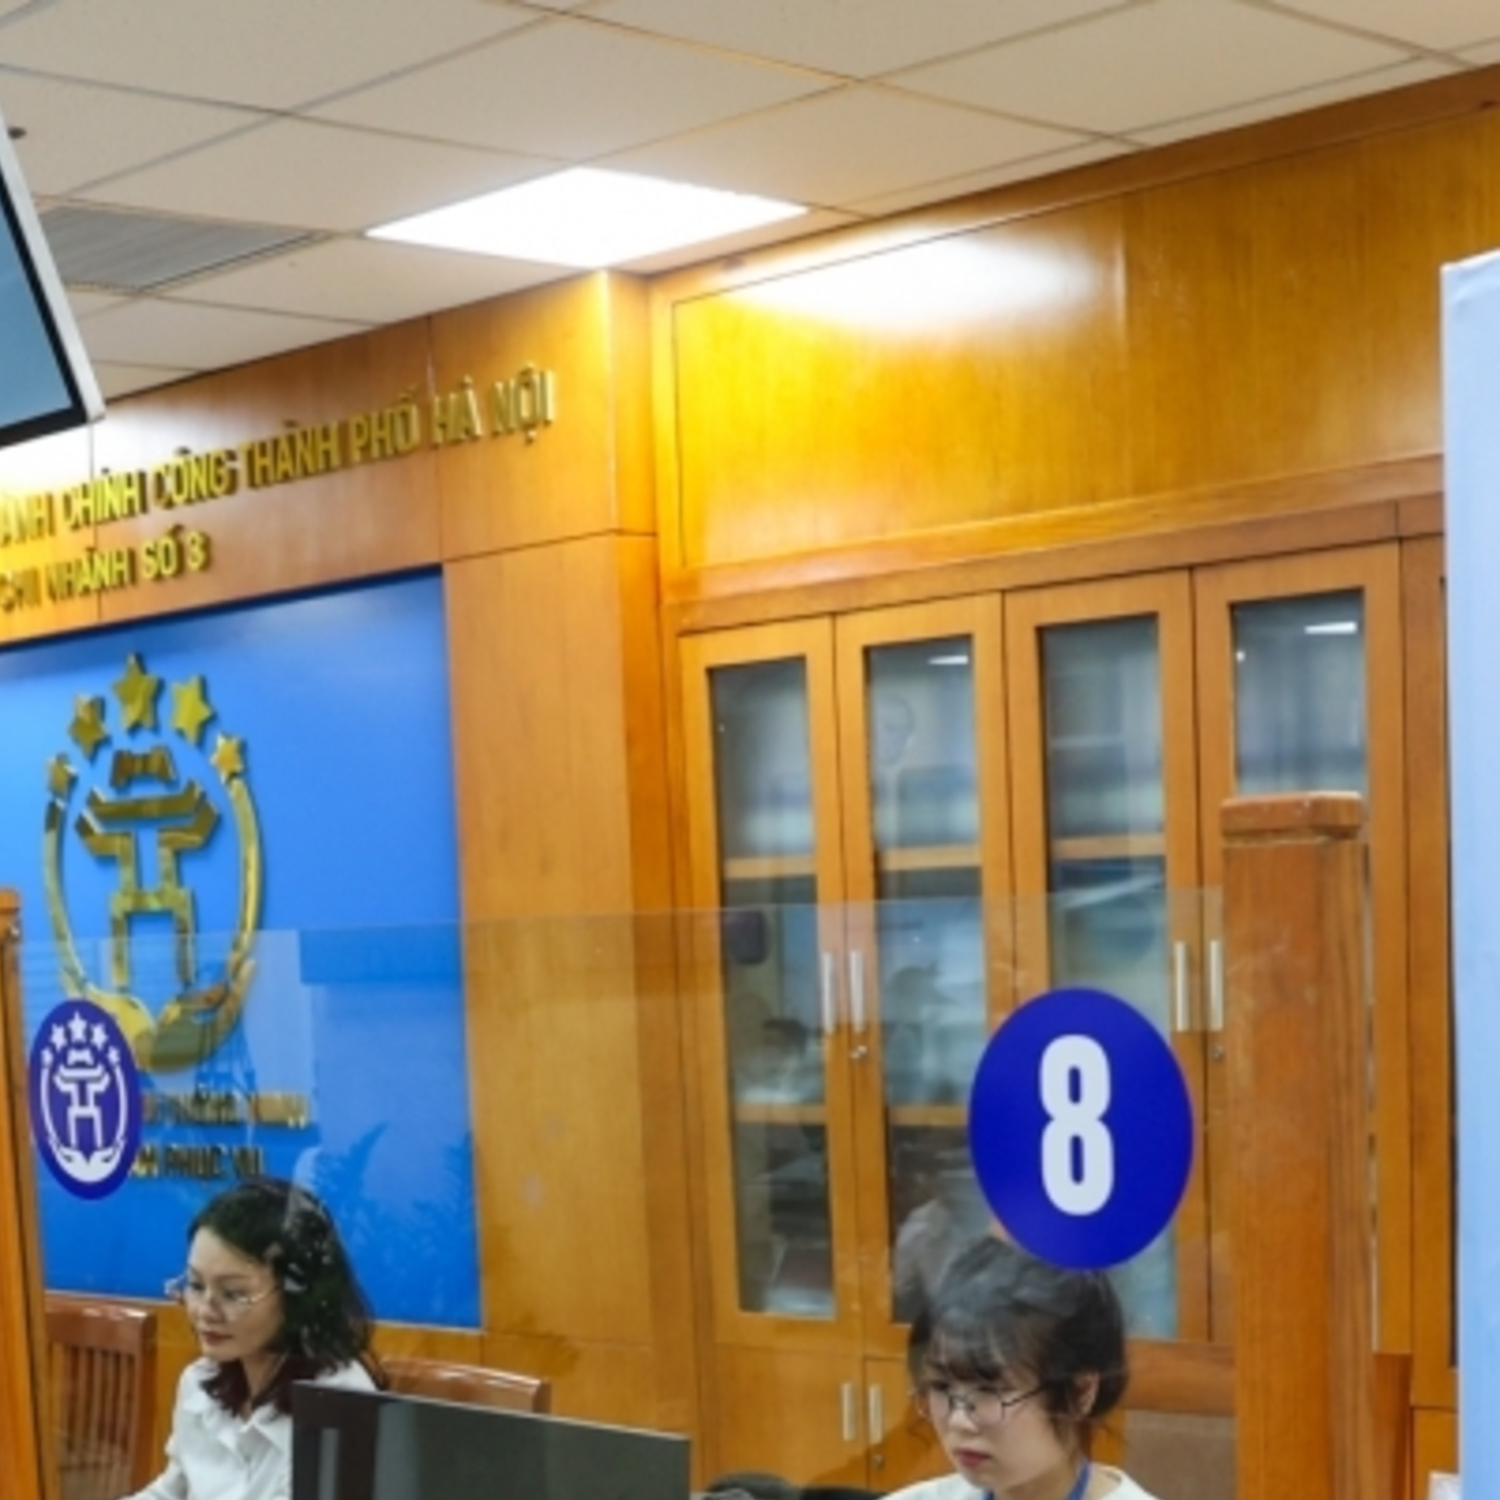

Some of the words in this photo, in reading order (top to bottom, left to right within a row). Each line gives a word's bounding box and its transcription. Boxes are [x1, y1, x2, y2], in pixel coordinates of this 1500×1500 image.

[152, 447, 238, 509] CÔNG
[237, 419, 341, 489] THÀNH
[348, 382, 422, 467] PHỐ
[430, 374, 482, 448] HÀ
[492, 361, 556, 447] NỘI
[140, 524, 183, 581] SỐ
[1039, 1034, 1115, 1216] 8
